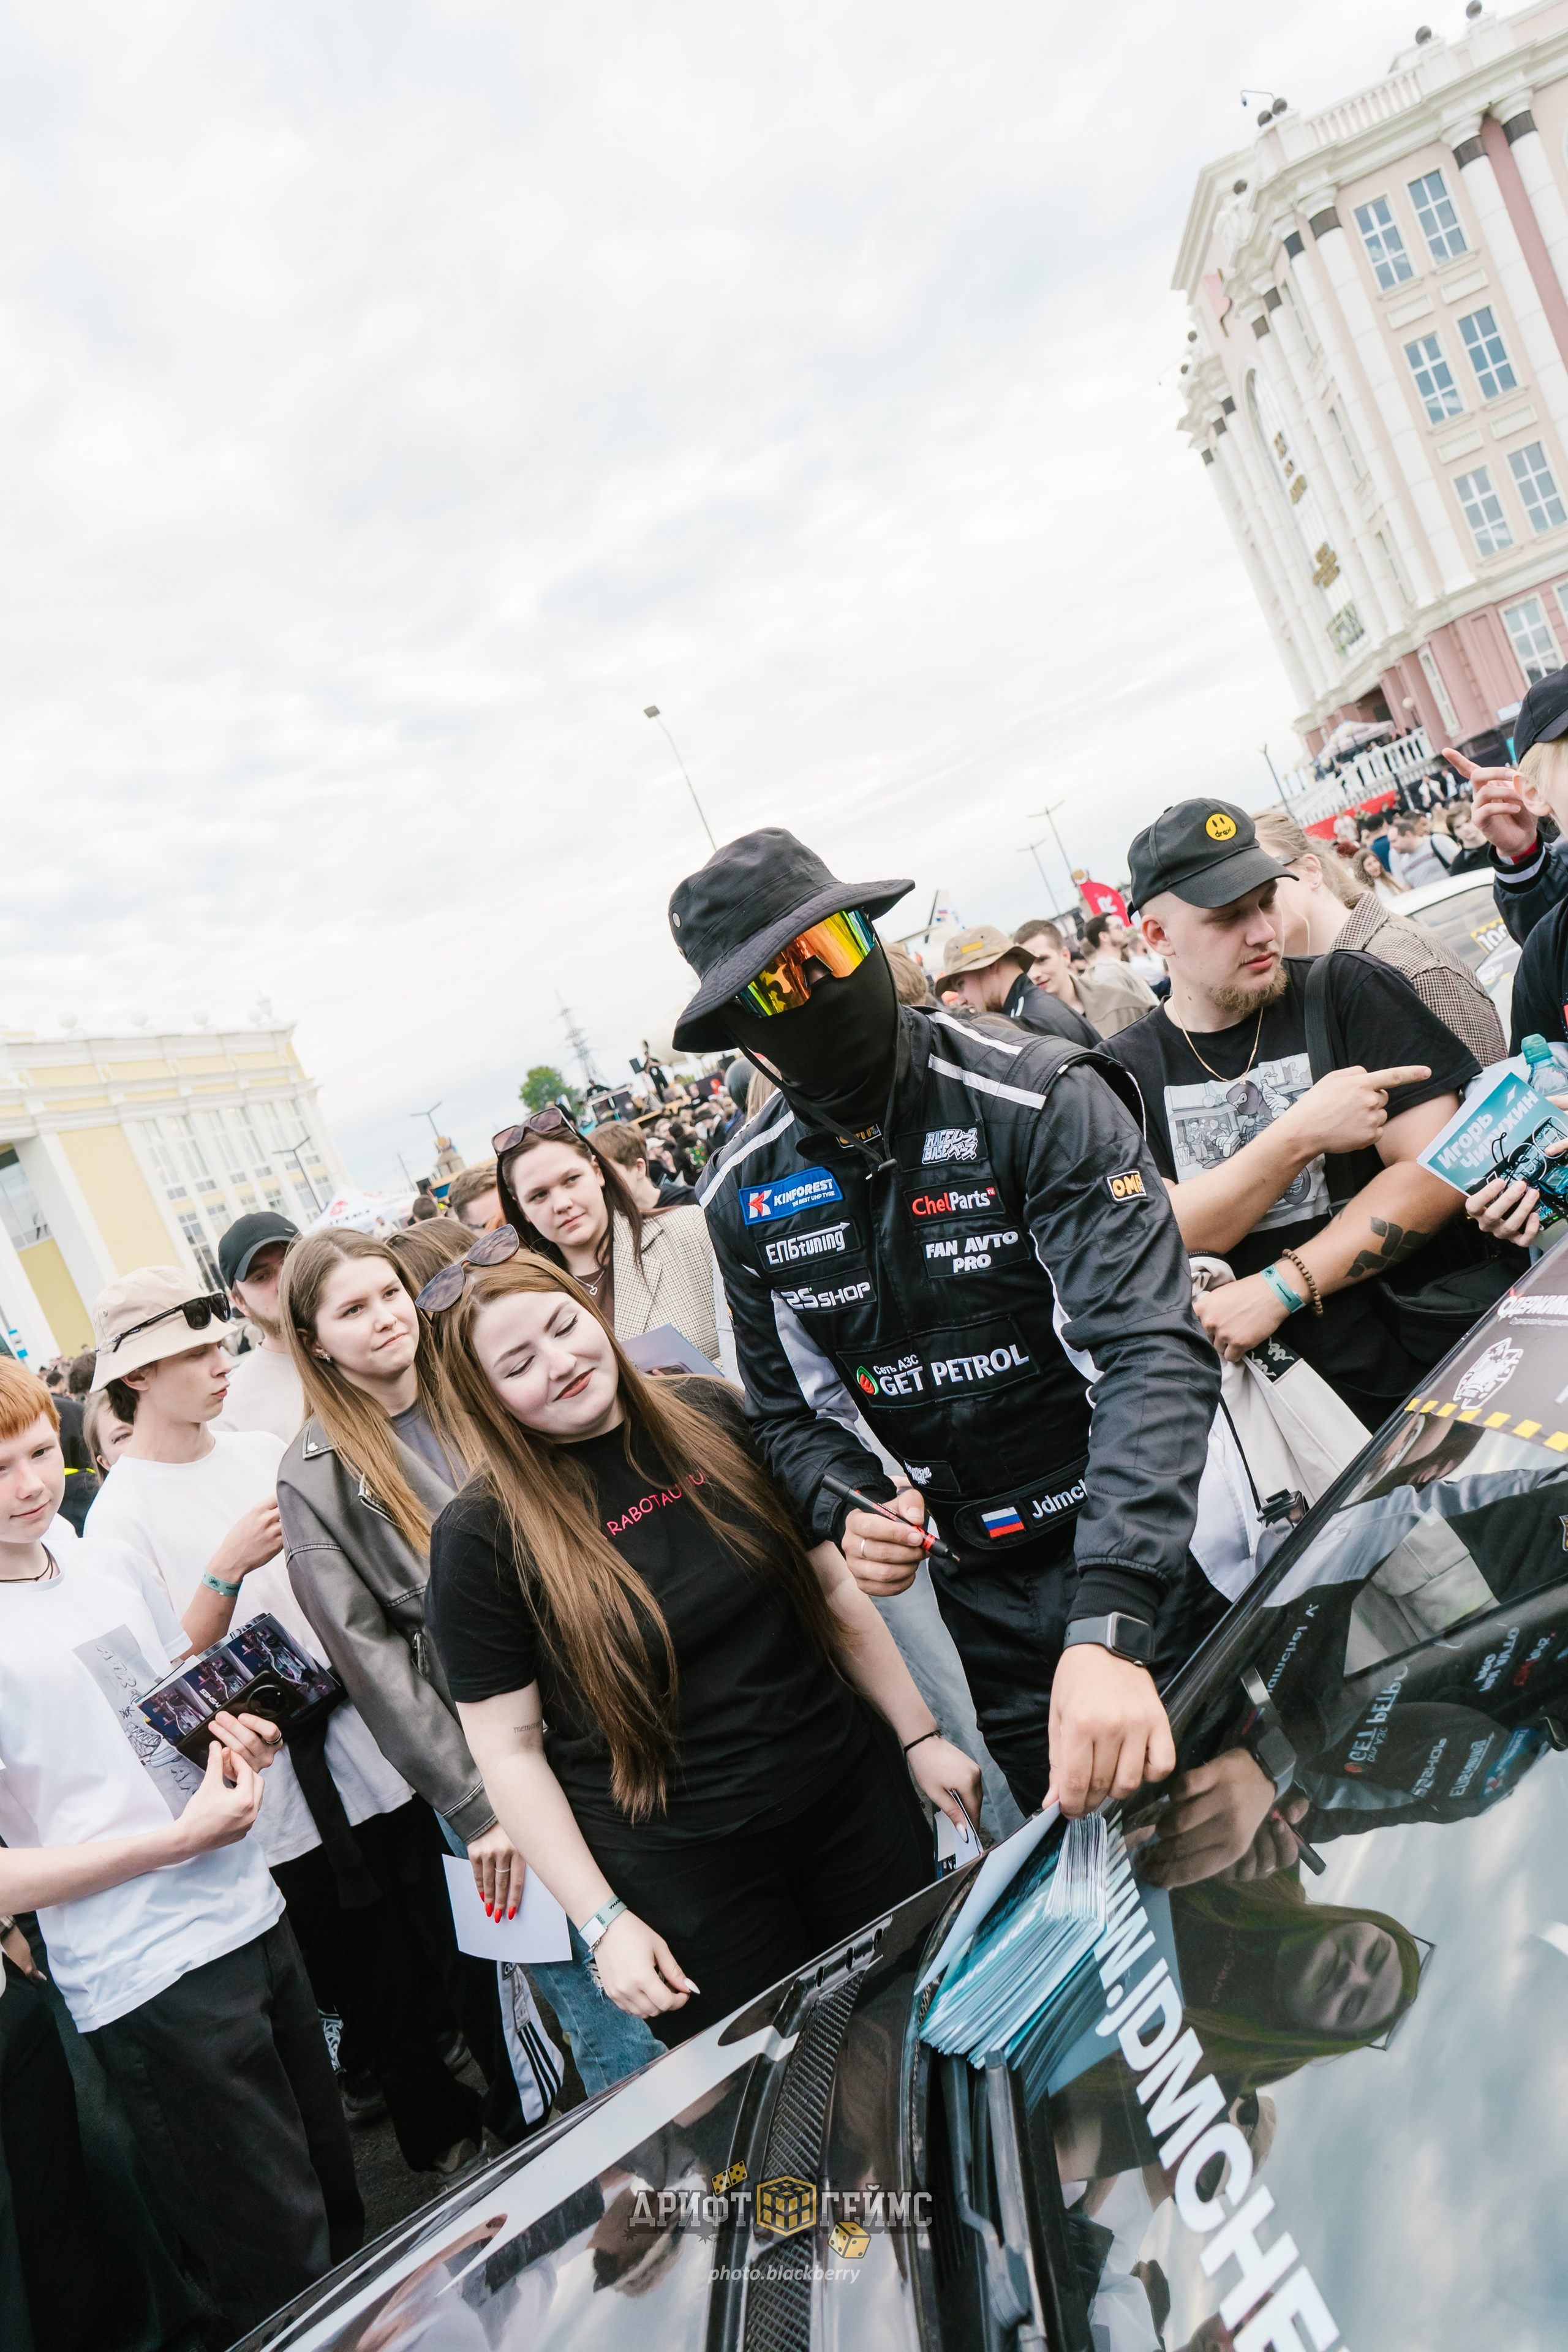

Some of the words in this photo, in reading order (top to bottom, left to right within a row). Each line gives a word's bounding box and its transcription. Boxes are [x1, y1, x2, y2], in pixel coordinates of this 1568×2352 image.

[1437, 1114, 1493, 1170] Игорь
[1460, 1090, 1539, 1168] Чирухин
[774, 1178, 833, 1206] KINFOREST
[799, 1196, 811, 1205] BEST
[812, 1194, 822, 1202] UHP
[823, 1191, 835, 1200] TYRE
[912, 1191, 990, 1216] ChelParts
[925, 1240, 957, 1258] FAN
[964, 1231, 1019, 1253] AVTO
[952, 1254, 992, 1273] PRO
[873, 1362, 897, 1376] Сеть
[897, 1354, 919, 1371] АЗС
[880, 1366, 922, 1396] GET
[930, 1344, 1030, 1386] PETROL
